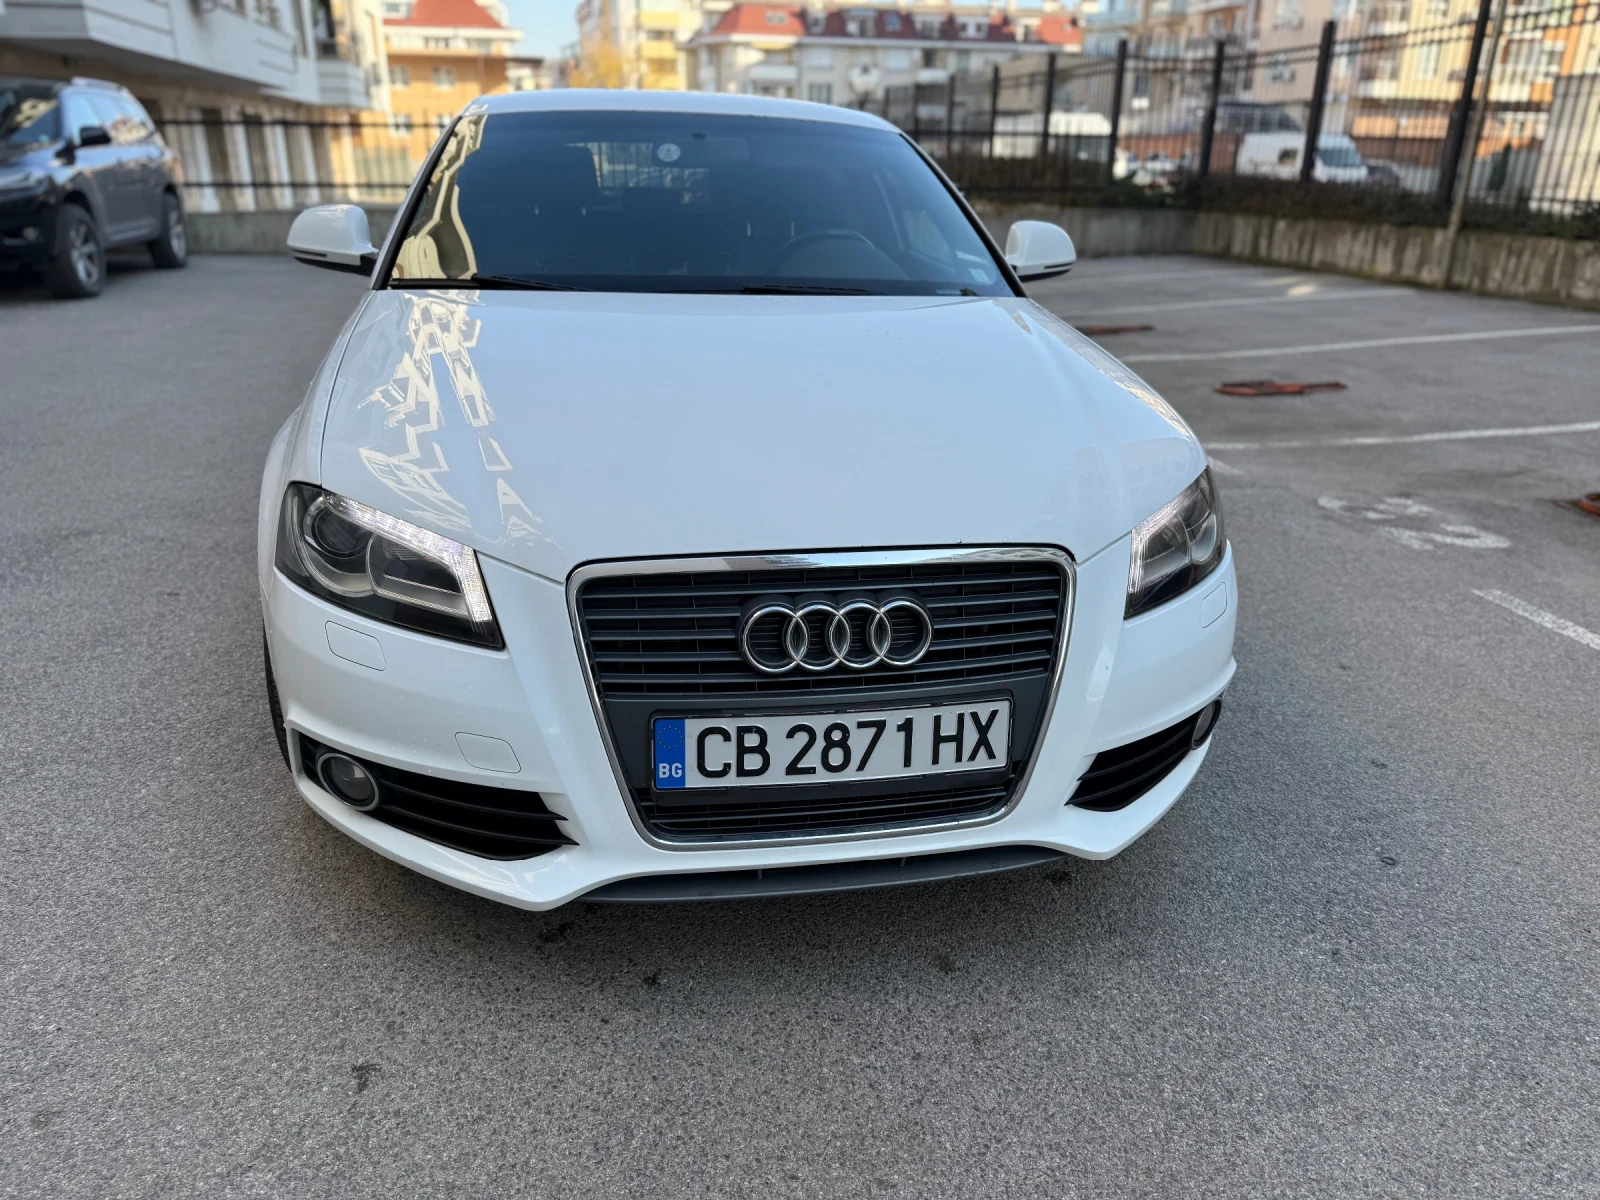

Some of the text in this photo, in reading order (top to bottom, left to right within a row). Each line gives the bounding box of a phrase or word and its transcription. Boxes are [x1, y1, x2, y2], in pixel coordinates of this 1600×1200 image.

[696, 709, 999, 778] CB 2871 HX
[658, 762, 683, 778] BG
